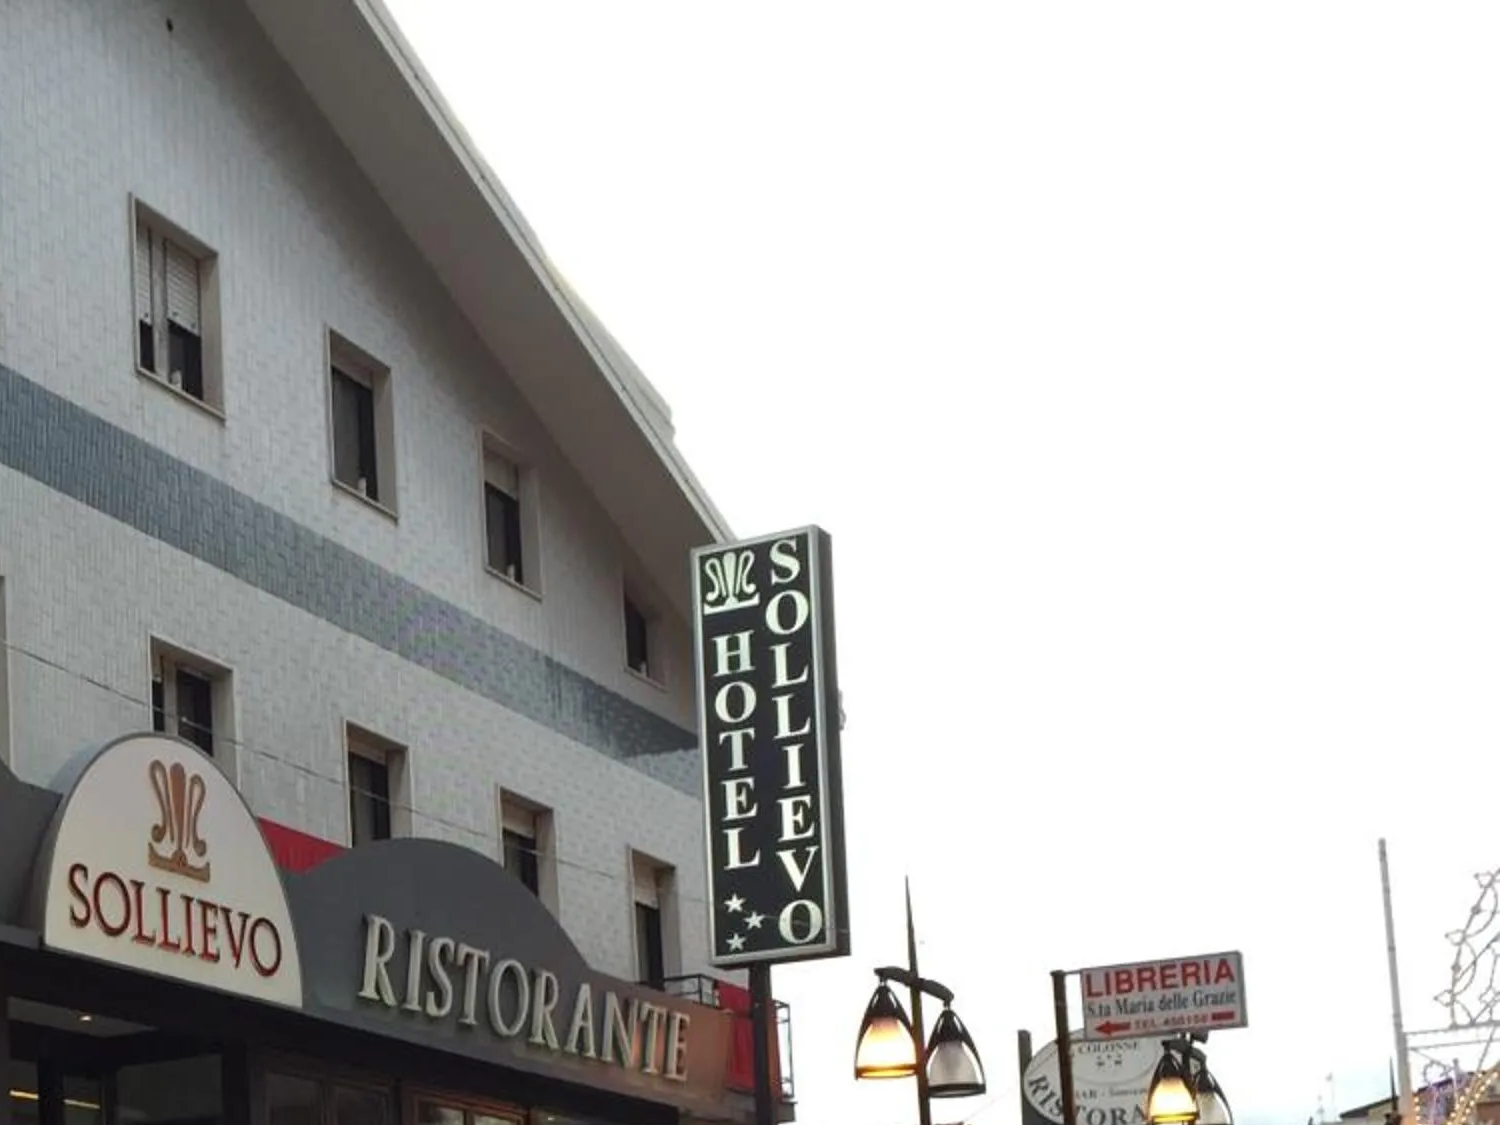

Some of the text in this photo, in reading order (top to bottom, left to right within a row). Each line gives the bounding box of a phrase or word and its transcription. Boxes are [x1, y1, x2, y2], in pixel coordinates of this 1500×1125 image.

[712, 630, 761, 871] HOTEL
[764, 538, 823, 945] SOLLIEVO
[67, 862, 283, 978] SOLLIEVO
[1085, 957, 1236, 998] LIBRERIA
[357, 913, 691, 1082] RISTORANTE
[1115, 997, 1155, 1015] Maria
[1158, 993, 1189, 1011] delle
[1193, 989, 1236, 1007] Grazie
